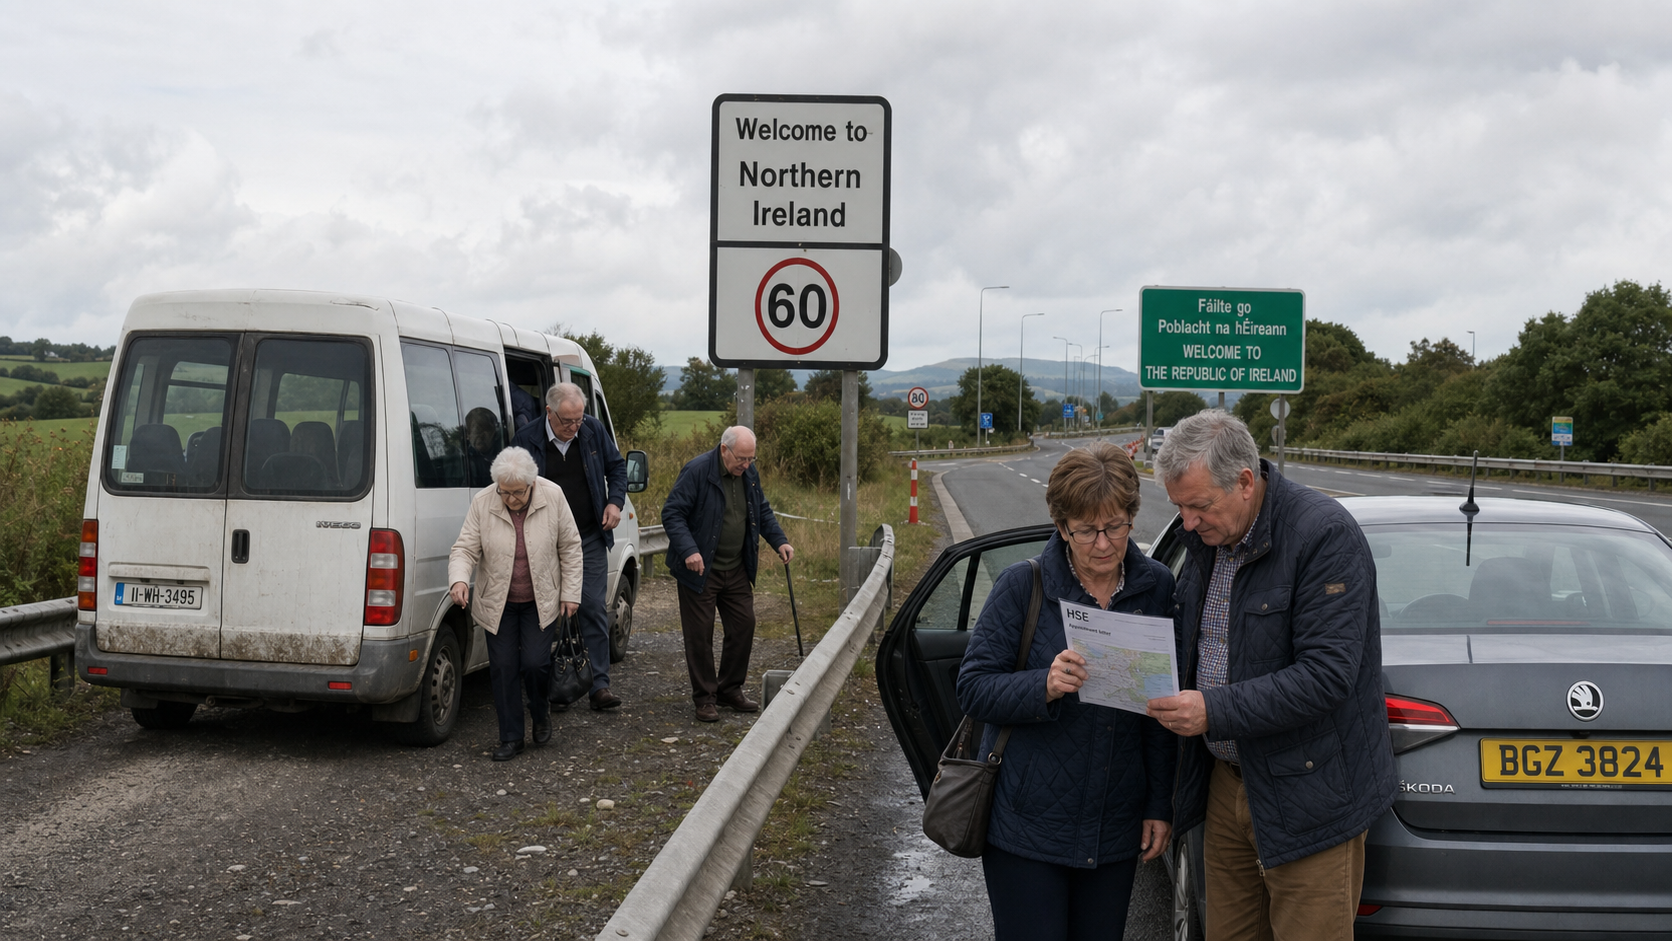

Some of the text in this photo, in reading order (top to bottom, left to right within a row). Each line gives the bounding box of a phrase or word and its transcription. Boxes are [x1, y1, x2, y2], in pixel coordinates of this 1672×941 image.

[735, 117, 868, 142] Welcome to
[739, 161, 861, 189] Northern
[753, 200, 846, 227] Ireland
[768, 283, 827, 329] 60
[1198, 298, 1251, 317] Fáilte go
[1158, 318, 1287, 336] Poblacht na hÉireann
[1183, 344, 1262, 360] WELCOME TO
[1145, 365, 1297, 383] THE REPUBLIC OF IRELAND
[912, 393, 924, 403] 80
[316, 521, 361, 529] IVECO
[131, 587, 195, 605] 11-WH-3495
[1066, 608, 1089, 622] HSE
[1499, 744, 1664, 778] BGZ 3824
